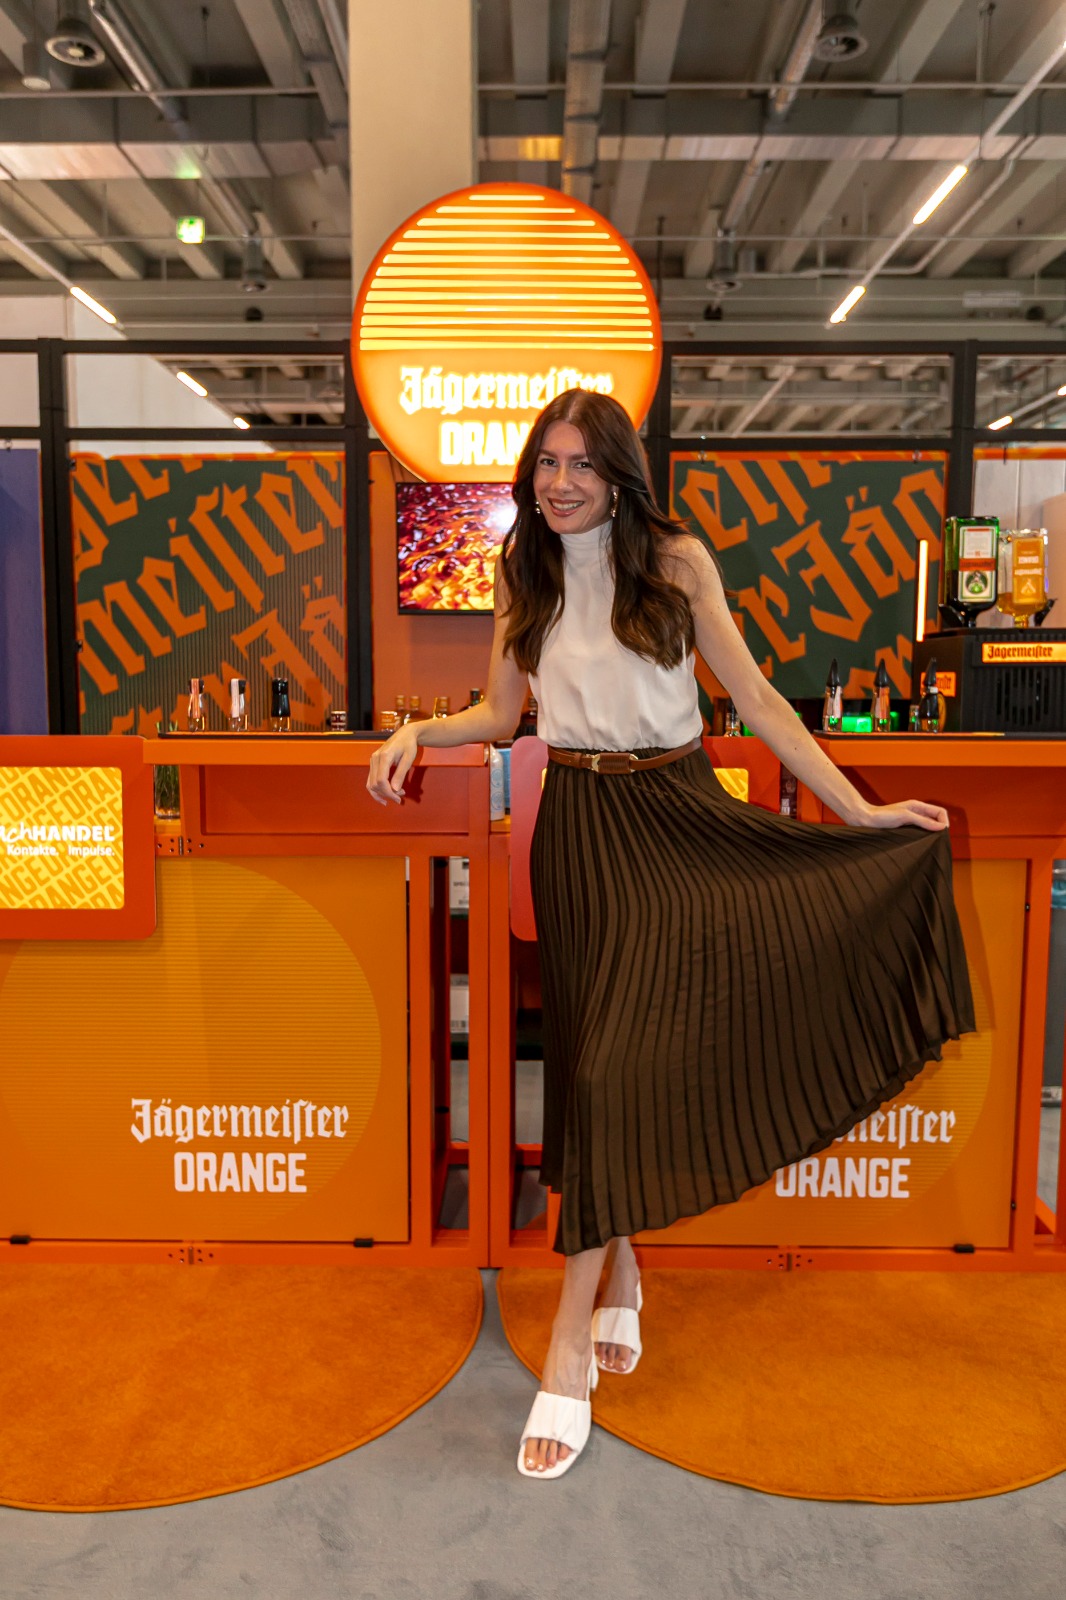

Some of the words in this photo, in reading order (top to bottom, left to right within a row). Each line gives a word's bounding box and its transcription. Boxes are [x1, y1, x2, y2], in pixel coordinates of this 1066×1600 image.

[441, 420, 535, 465] ORAN
[131, 1098, 349, 1144] Jägermeister
[834, 1103, 956, 1149] eister
[174, 1152, 307, 1192] ORANGE
[775, 1157, 911, 1198] ORANGE
